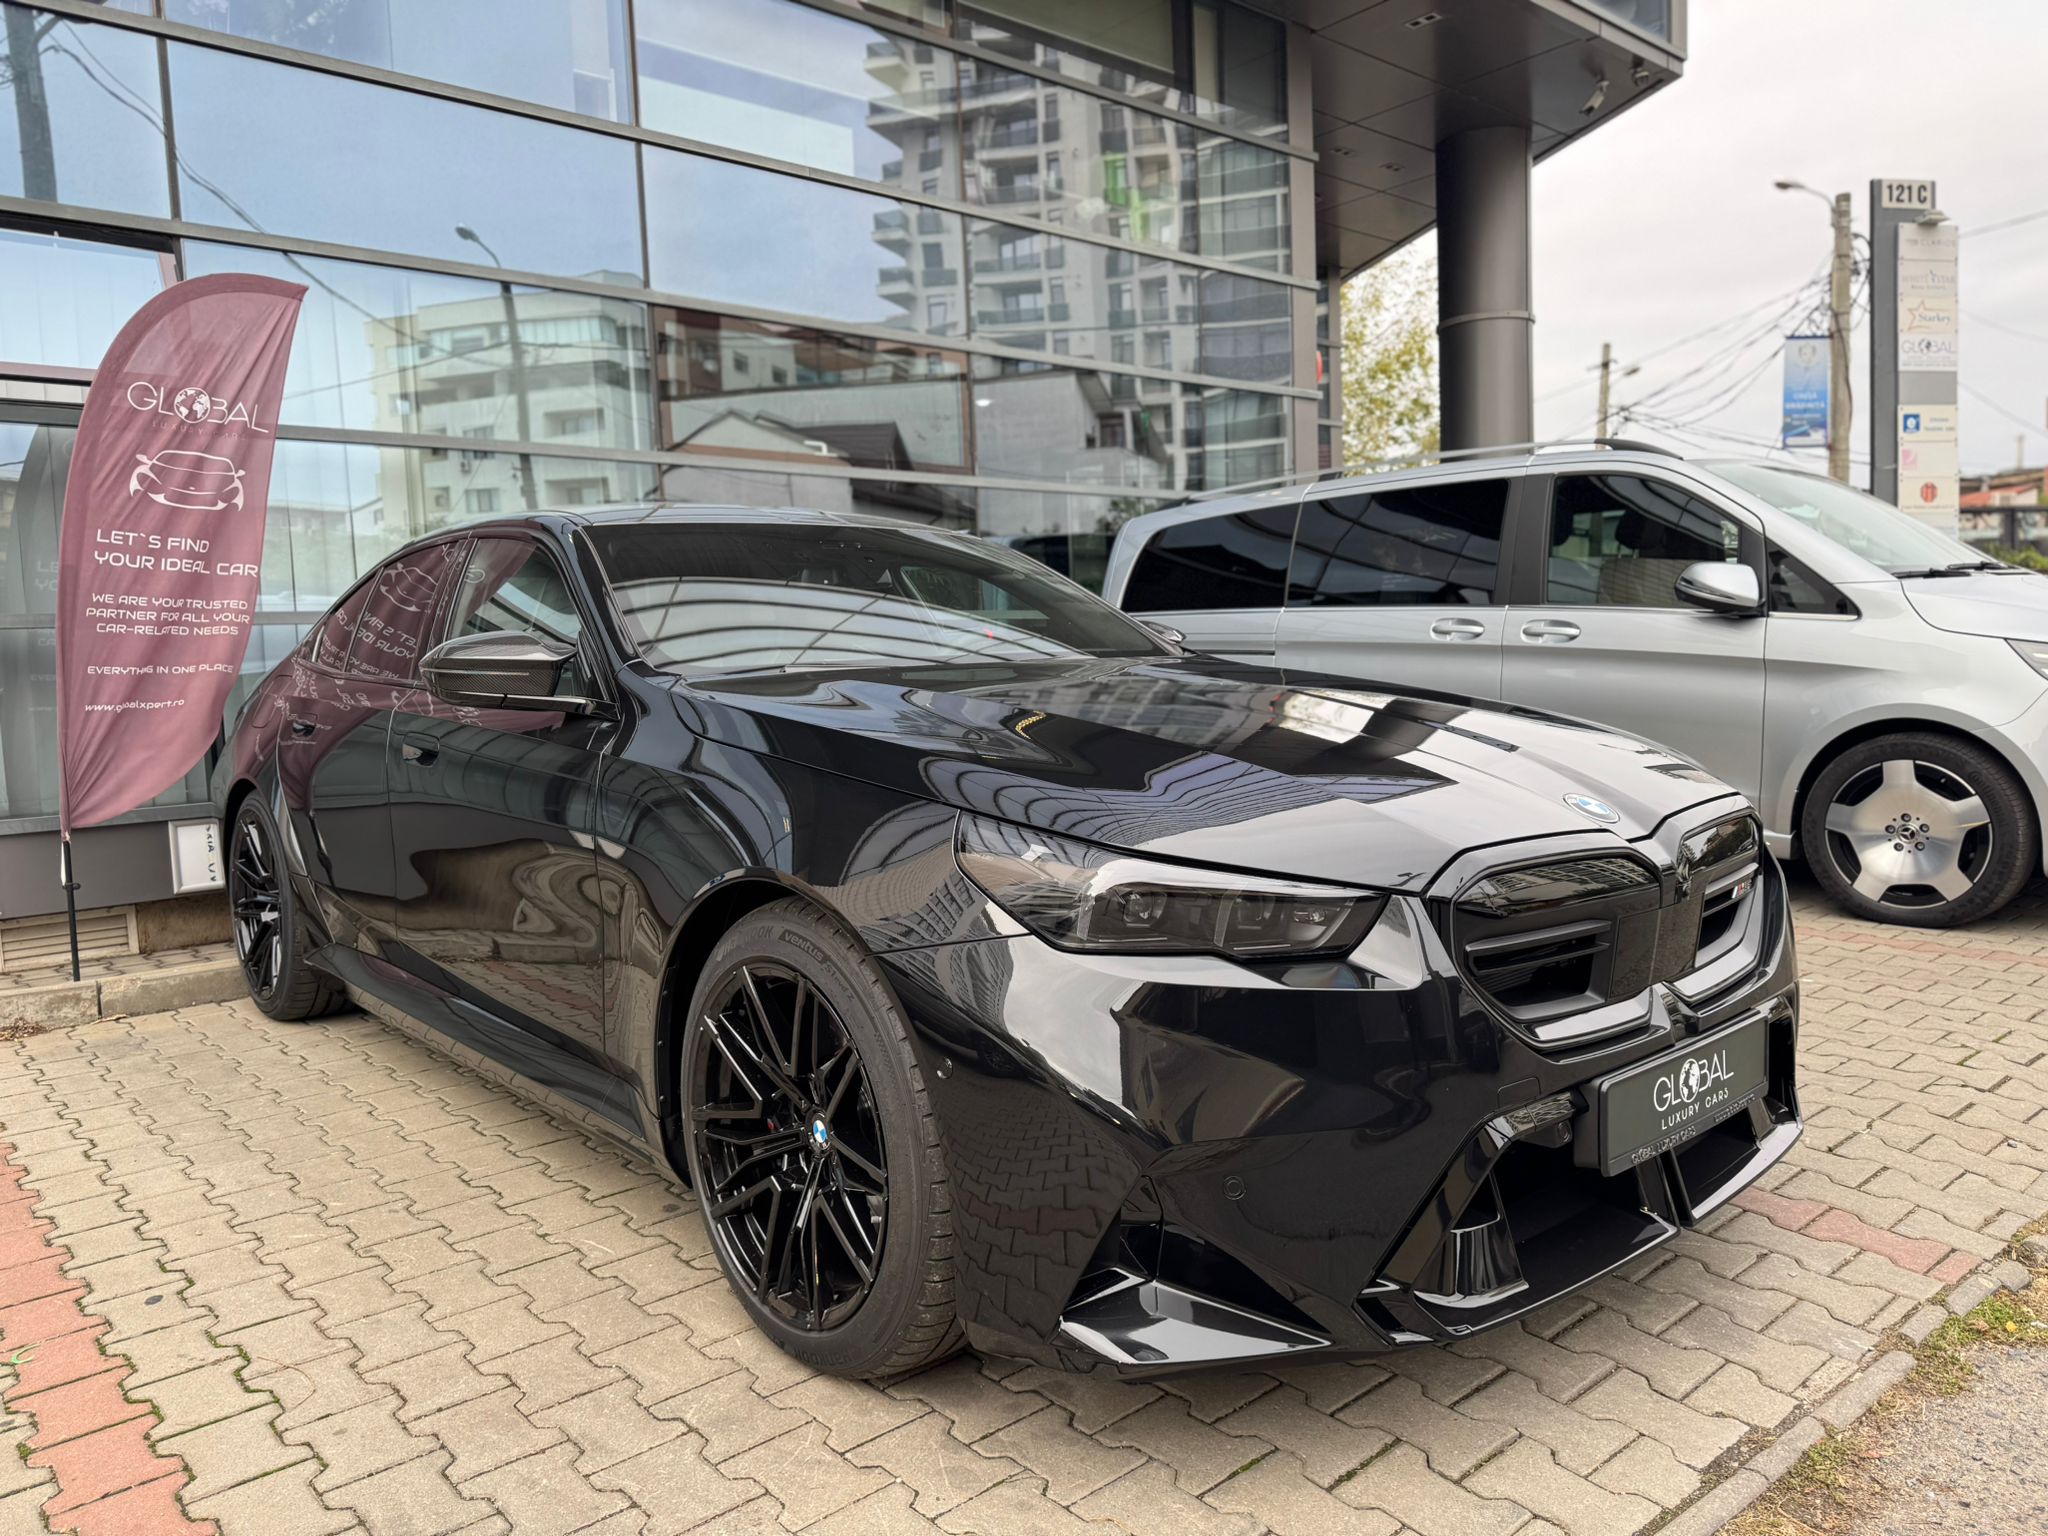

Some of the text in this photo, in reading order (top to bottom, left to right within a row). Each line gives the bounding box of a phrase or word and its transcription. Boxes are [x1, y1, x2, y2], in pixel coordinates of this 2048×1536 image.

[1886, 184, 1928, 204] 121 C
[127, 381, 269, 433] GLOBAL
[167, 537, 210, 553] FIND
[94, 550, 259, 578] YOUR IDEAL CAR
[92, 593, 248, 610] WE ARE YOUR TRUSTED
[86, 607, 251, 624] PARTNER FOR ALL YOUR
[96, 623, 239, 636] CAR-RELATED NEEDS
[156, 665, 169, 674] IN
[171, 665, 197, 675] ONE
[198, 663, 234, 673] PLACE
[1653, 1050, 1735, 1112] GLOBAL
[1661, 1102, 1701, 1131] LUXURY
[1705, 1087, 1729, 1109] CARS
